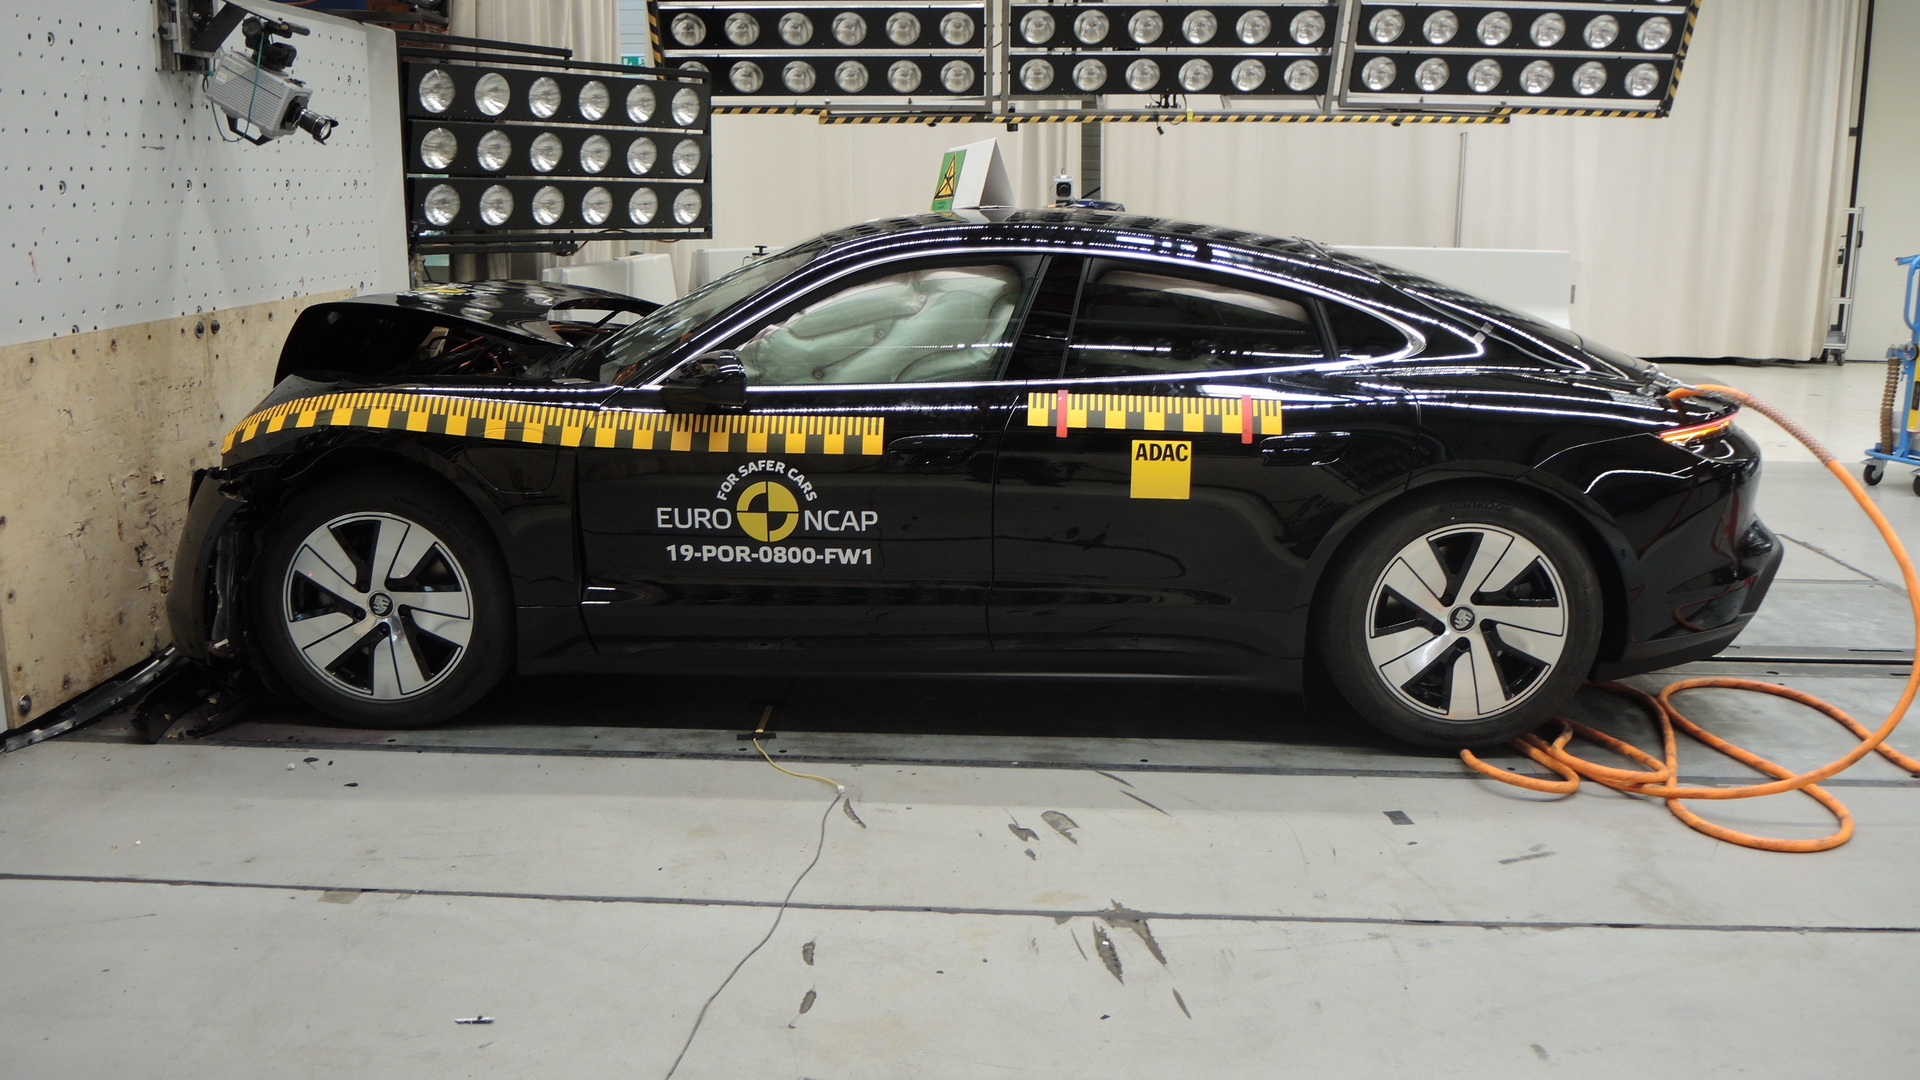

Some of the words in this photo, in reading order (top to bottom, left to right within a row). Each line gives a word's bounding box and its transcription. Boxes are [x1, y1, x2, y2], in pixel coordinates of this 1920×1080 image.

[1135, 443, 1188, 462] ADAC
[716, 473, 740, 501] FOR
[738, 460, 786, 478] SAFER
[787, 467, 818, 502] CARS
[656, 507, 732, 530] EURO
[804, 510, 879, 532] NCAP
[666, 544, 872, 565] 19-POR-0800-FW1
